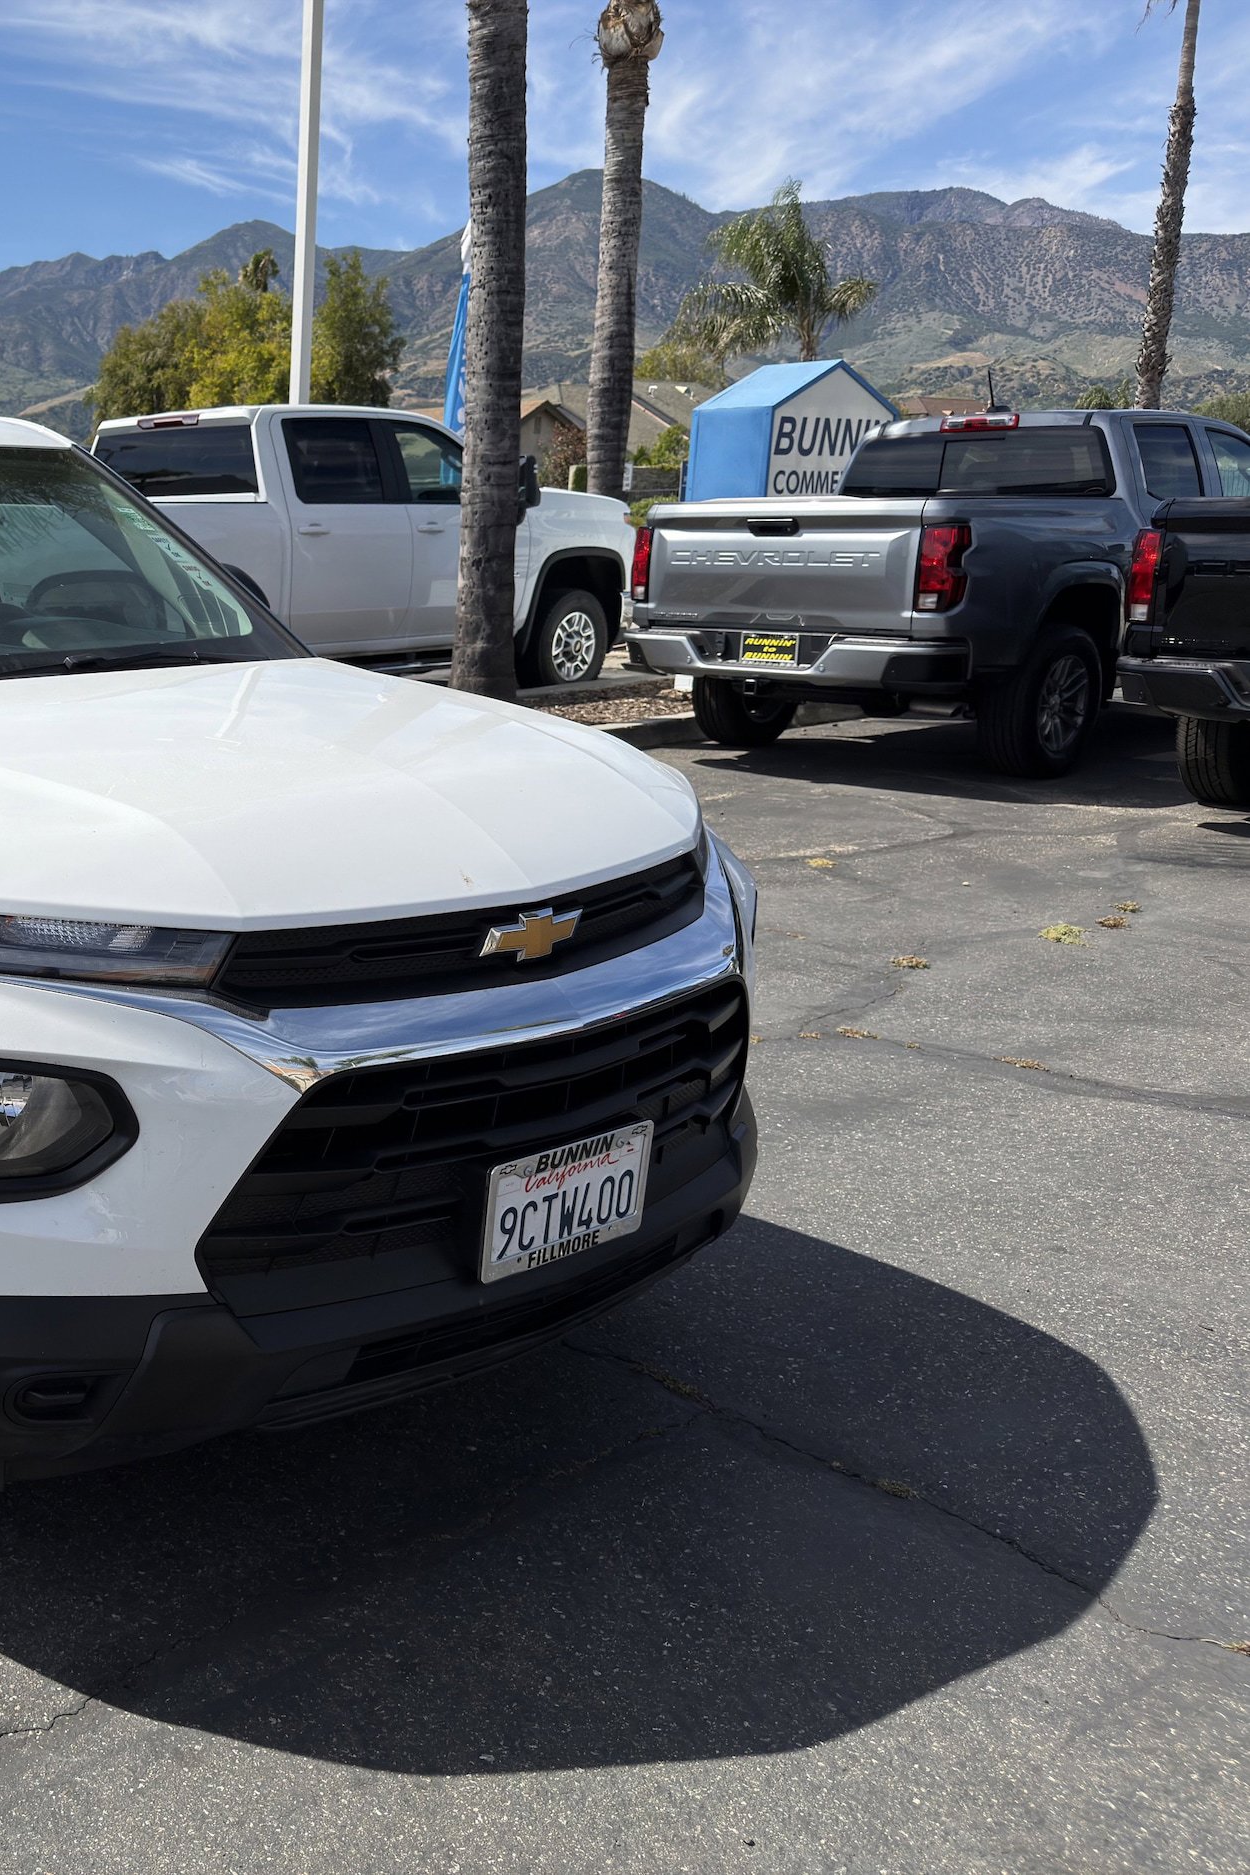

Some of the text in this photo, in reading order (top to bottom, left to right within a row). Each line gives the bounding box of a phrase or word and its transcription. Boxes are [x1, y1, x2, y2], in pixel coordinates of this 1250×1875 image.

[774, 416, 880, 456] BUNN
[773, 470, 843, 494] COMME
[670, 550, 881, 567] CHEVROLET
[743, 652, 793, 660] BUNNIN
[525, 1152, 621, 1193] California
[535, 1134, 615, 1173] BUNNIN
[496, 1169, 634, 1261] 9CTW400
[527, 1230, 601, 1269] FILLMORE
